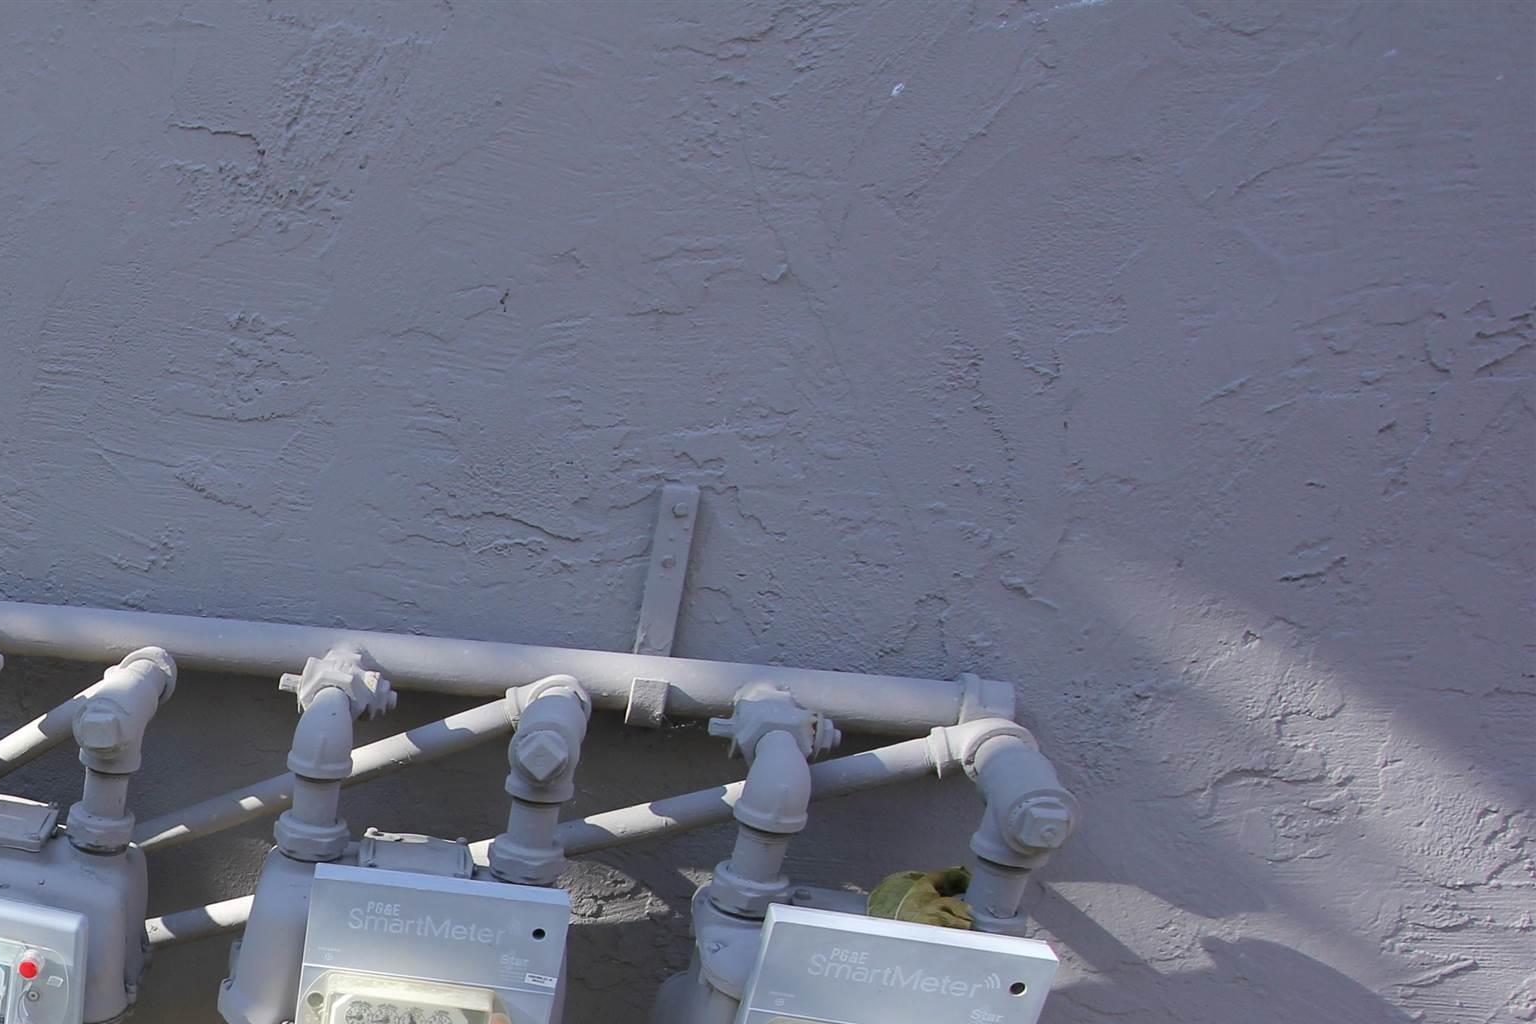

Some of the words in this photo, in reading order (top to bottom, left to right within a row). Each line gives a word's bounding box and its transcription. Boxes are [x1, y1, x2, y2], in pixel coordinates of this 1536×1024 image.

[366, 901, 401, 917] PG&E
[347, 907, 505, 945] SmartMeter
[830, 947, 871, 966] PG&E
[807, 953, 984, 999] SmartMeter
